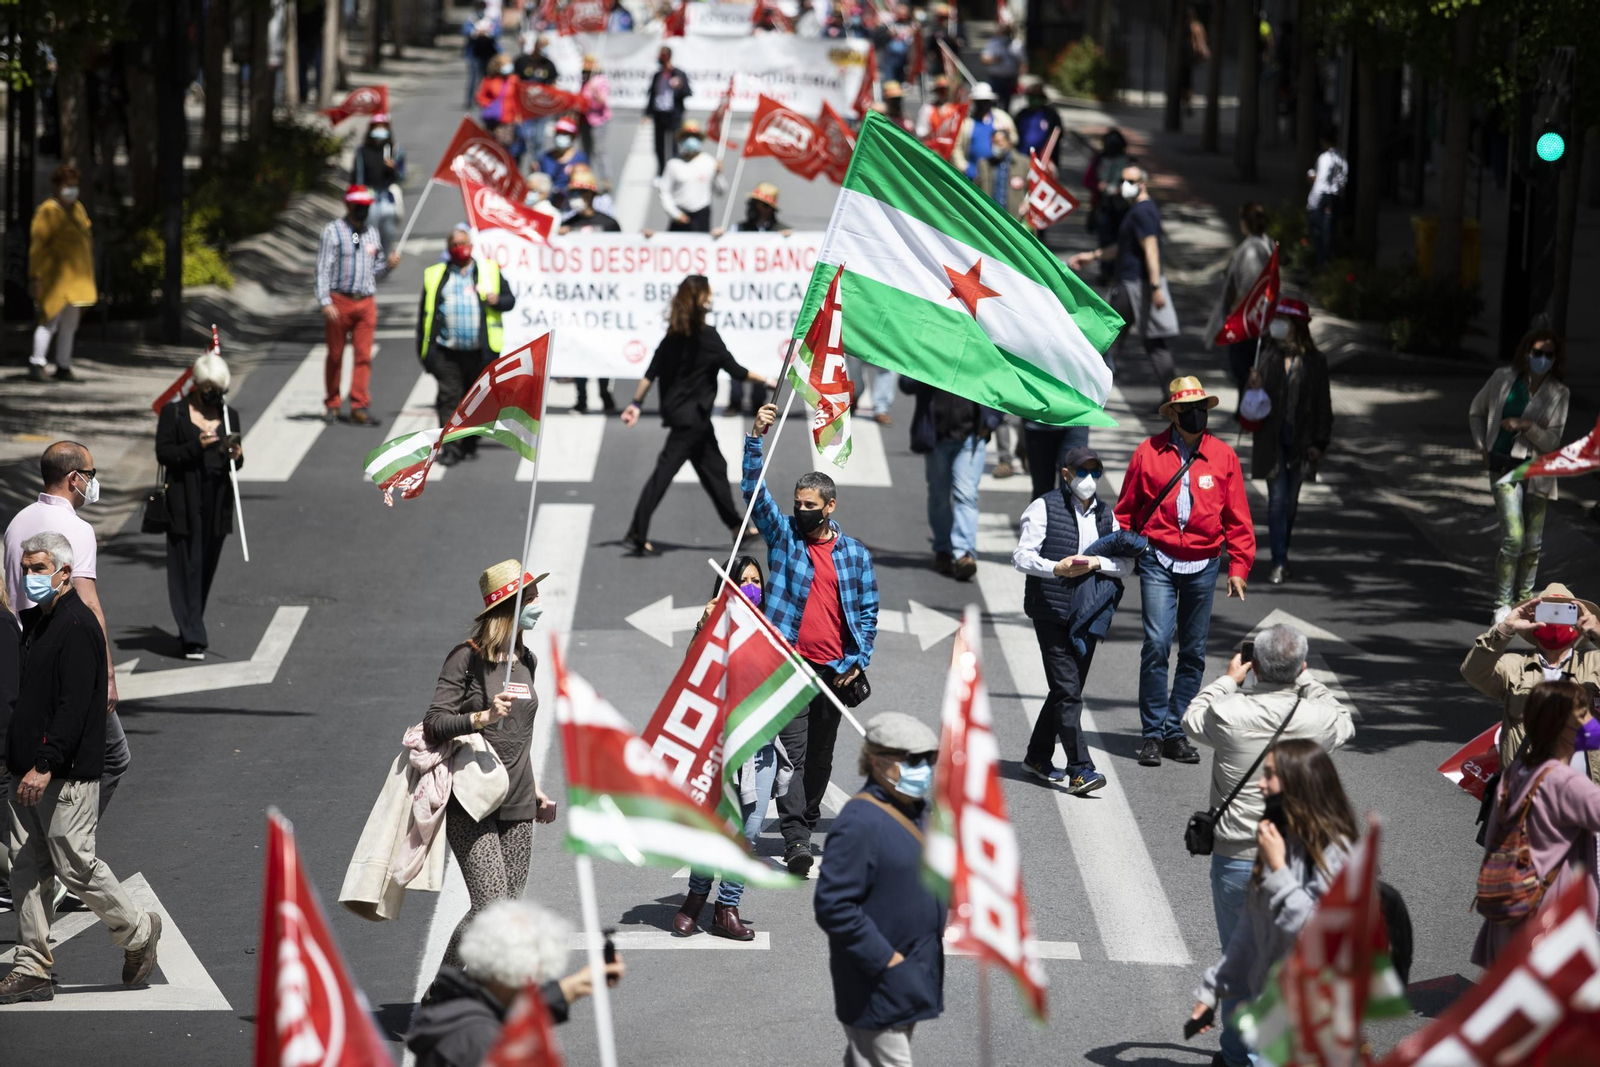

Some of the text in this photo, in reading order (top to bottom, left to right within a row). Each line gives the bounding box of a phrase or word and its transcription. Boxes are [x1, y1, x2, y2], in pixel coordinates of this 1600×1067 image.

[518, 248, 531, 269] A
[539, 246, 582, 273] LOS
[591, 246, 707, 274] DESPIDOS
[716, 247, 745, 273] EN
[754, 247, 818, 273] BANC
[521, 307, 638, 331] SABADELL
